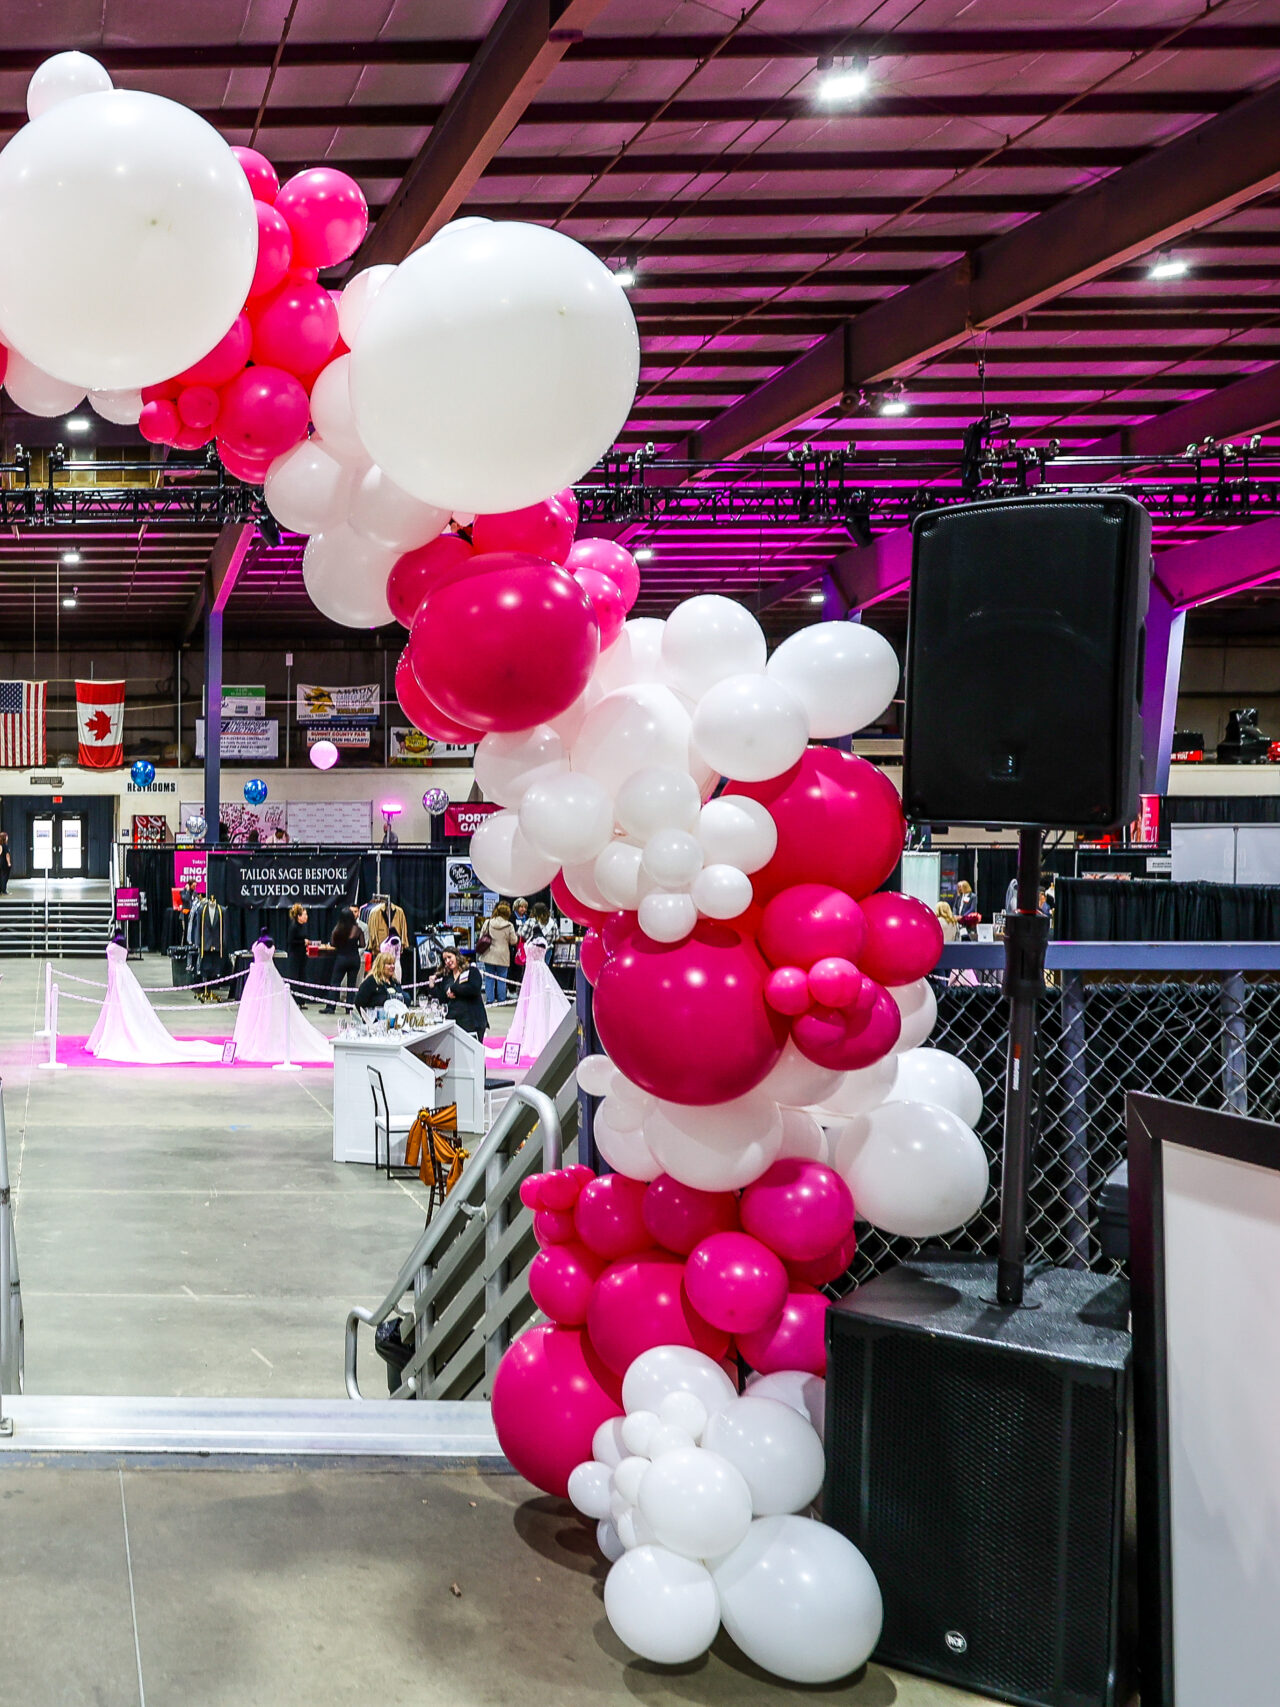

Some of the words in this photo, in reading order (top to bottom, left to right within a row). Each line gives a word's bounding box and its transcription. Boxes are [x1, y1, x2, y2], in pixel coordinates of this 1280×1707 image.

[458, 813, 488, 823] PORT
[183, 867, 207, 875] ENGA
[240, 868, 277, 881] TAILOR
[278, 868, 302, 881] SAGE
[305, 867, 348, 880] BESPOKE
[240, 885, 250, 897] &
[251, 884, 300, 897] TUXEDO
[303, 883, 347, 896] RENTAL
